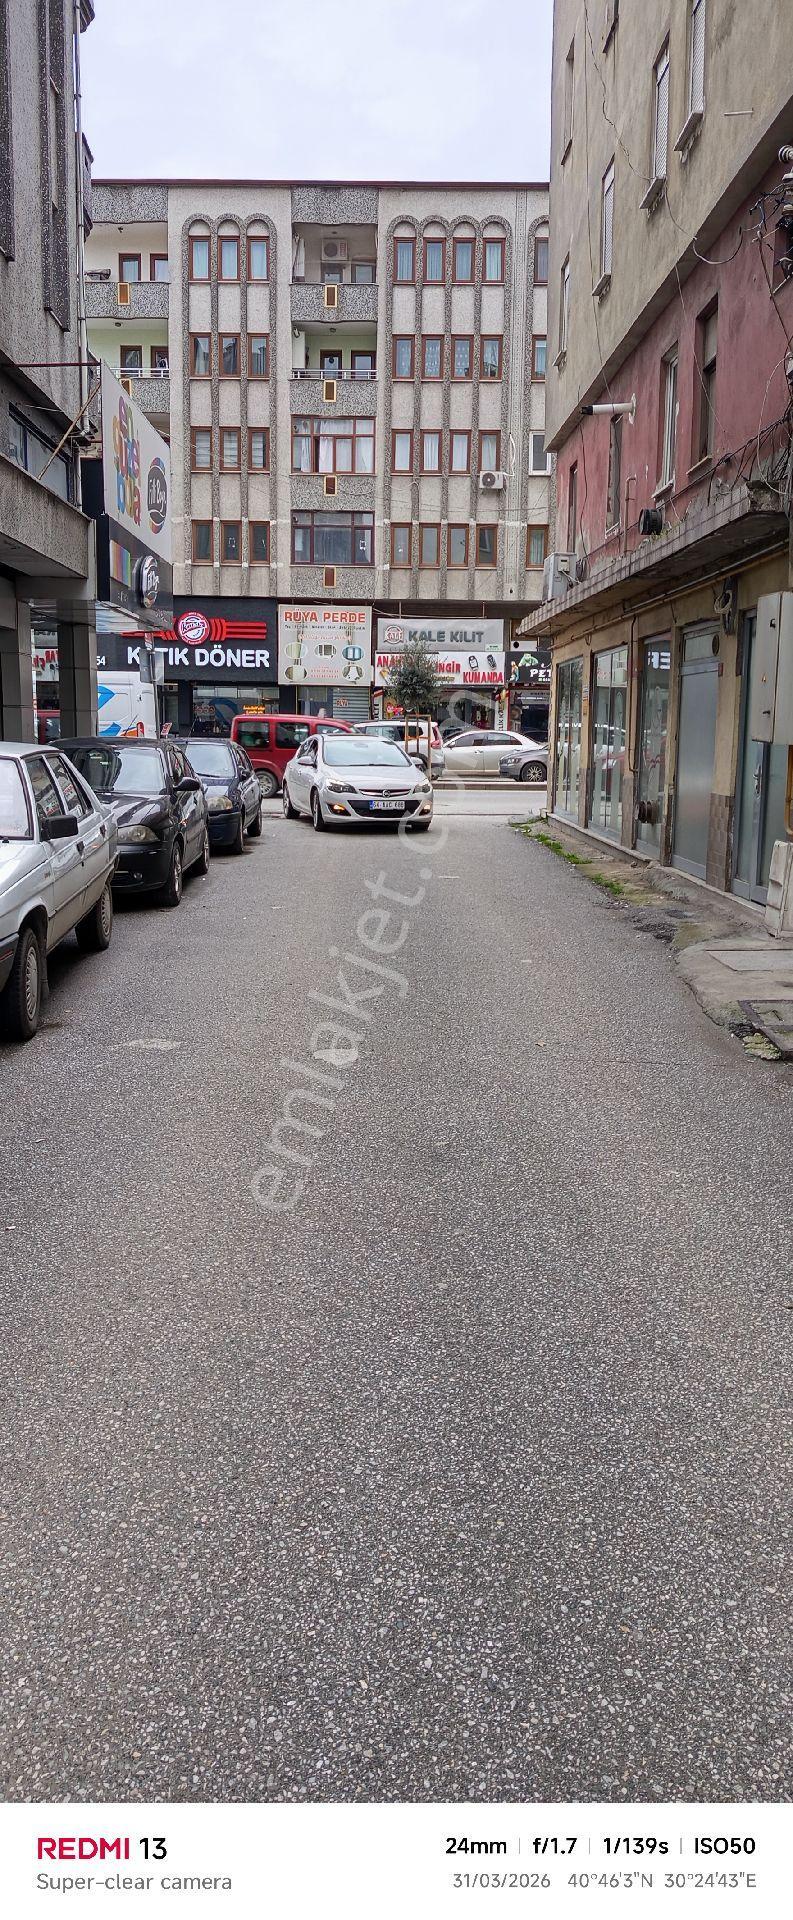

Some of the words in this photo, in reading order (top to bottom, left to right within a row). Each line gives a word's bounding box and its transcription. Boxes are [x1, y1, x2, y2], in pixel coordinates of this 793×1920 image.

[284, 609, 318, 623] RÜYA
[324, 611, 366, 623] PERDE
[408, 630, 446, 643] KALE
[195, 644, 270, 668] DÖNER
[463, 671, 503, 684] KUMANDA
